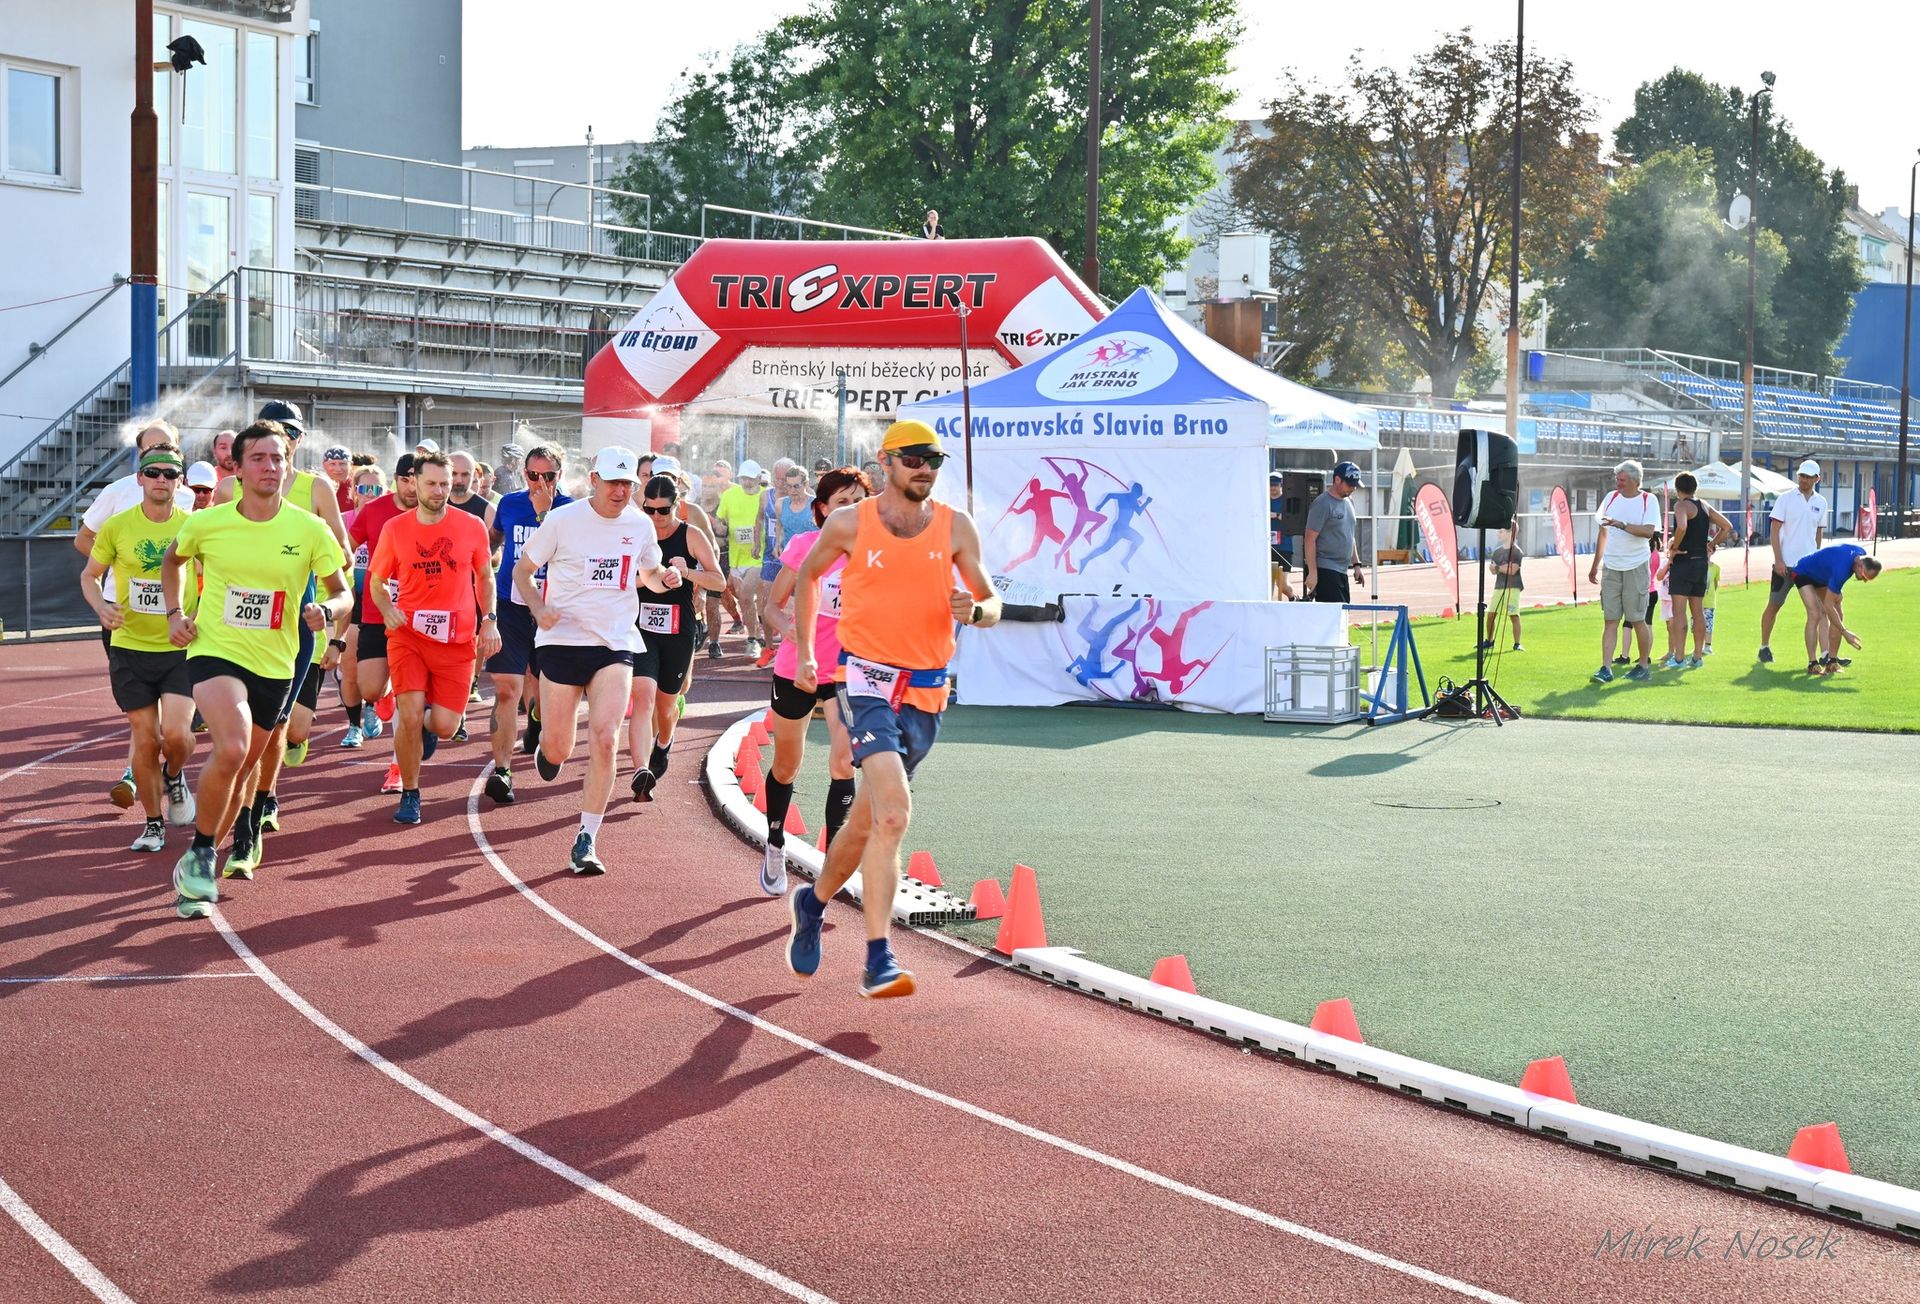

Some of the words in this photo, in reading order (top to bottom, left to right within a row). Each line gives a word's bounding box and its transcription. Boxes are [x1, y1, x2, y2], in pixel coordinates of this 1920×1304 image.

[711, 264, 997, 313] TRIEXPERT
[619, 331, 640, 347] VR
[641, 331, 698, 351] Group
[752, 360, 825, 381] Brněnský
[831, 361, 867, 377] letní
[872, 361, 935, 381] běžecký
[1070, 369, 1140, 381] MISTRÁK
[1059, 381, 1088, 389] JAK
[1092, 379, 1138, 388] BRNO
[769, 388, 907, 412] TRIEPERT
[935, 416, 962, 438] AC
[971, 412, 1084, 438] Moravská
[1093, 412, 1164, 437] Slavia
[1174, 413, 1228, 436] Brno
[425, 567, 441, 575] RUN
[592, 570, 613, 581] 204
[137, 594, 159, 606] 104
[231, 590, 270, 599] TRIEXPERT
[243, 597, 269, 605] CUP
[235, 605, 262, 620] 209
[648, 616, 665, 627] 202
[425, 625, 437, 635] 78
